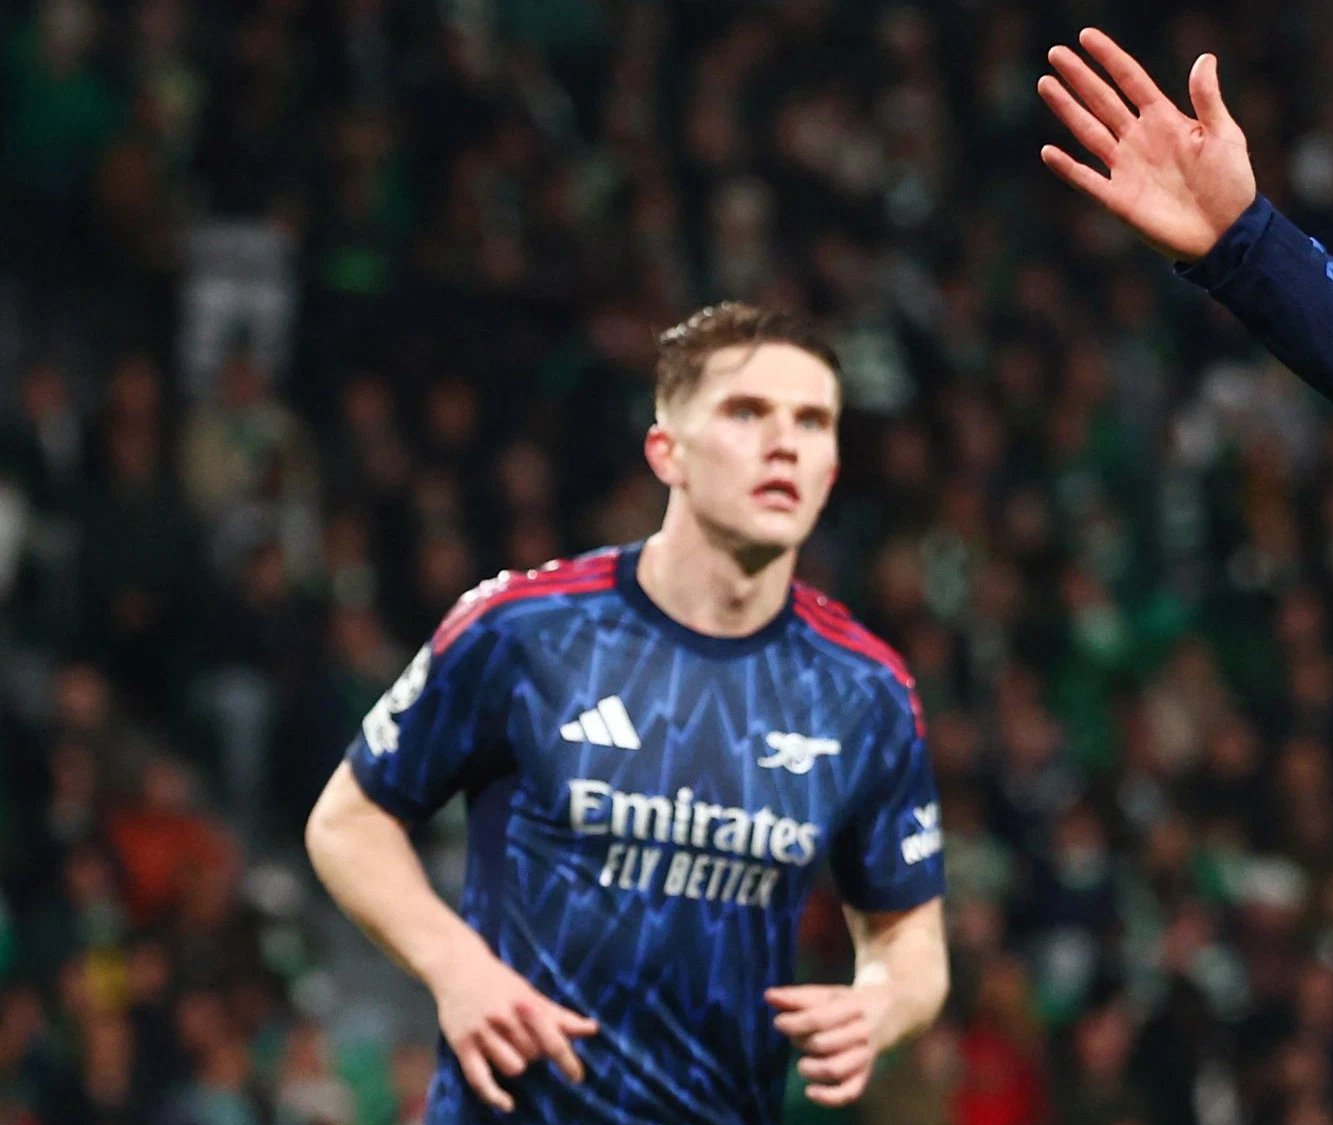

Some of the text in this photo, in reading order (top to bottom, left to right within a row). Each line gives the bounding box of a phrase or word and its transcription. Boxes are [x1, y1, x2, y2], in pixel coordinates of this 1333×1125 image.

[568, 778, 819, 867] Emirates
[599, 842, 783, 909] FLY BETTER
